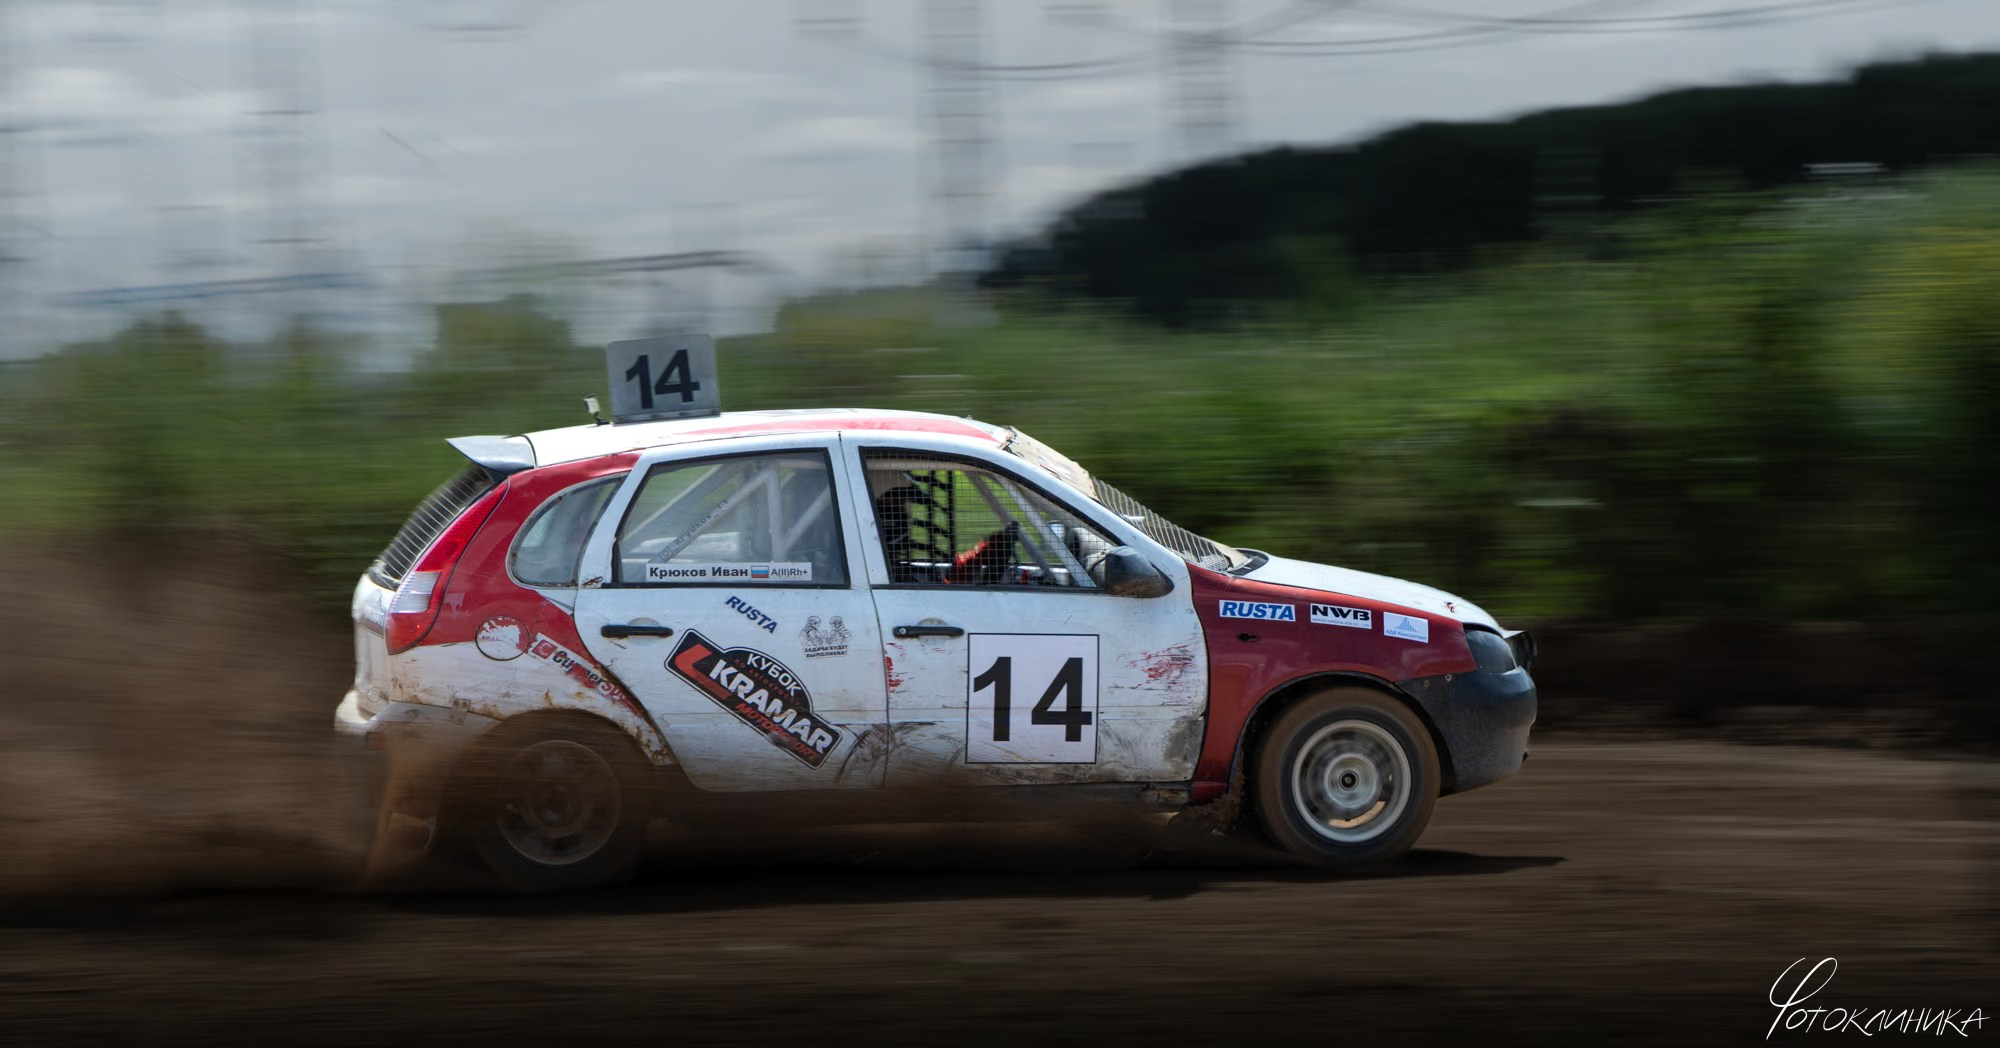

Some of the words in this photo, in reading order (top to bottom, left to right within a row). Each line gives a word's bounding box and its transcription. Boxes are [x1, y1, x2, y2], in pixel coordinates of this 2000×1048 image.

[625, 348, 700, 409] 14
[649, 567, 707, 579] Крюков
[711, 566, 749, 577] Иван
[770, 567, 809, 578] A(II)Rh+
[725, 595, 778, 634] RUSTA
[1221, 601, 1295, 621] RUSTA
[1311, 605, 1370, 621] NWB
[804, 645, 829, 653] ЗАДАЧА
[747, 653, 802, 697] КУБОК
[708, 658, 833, 754] KRAMAR
[973, 656, 1093, 743] 14
